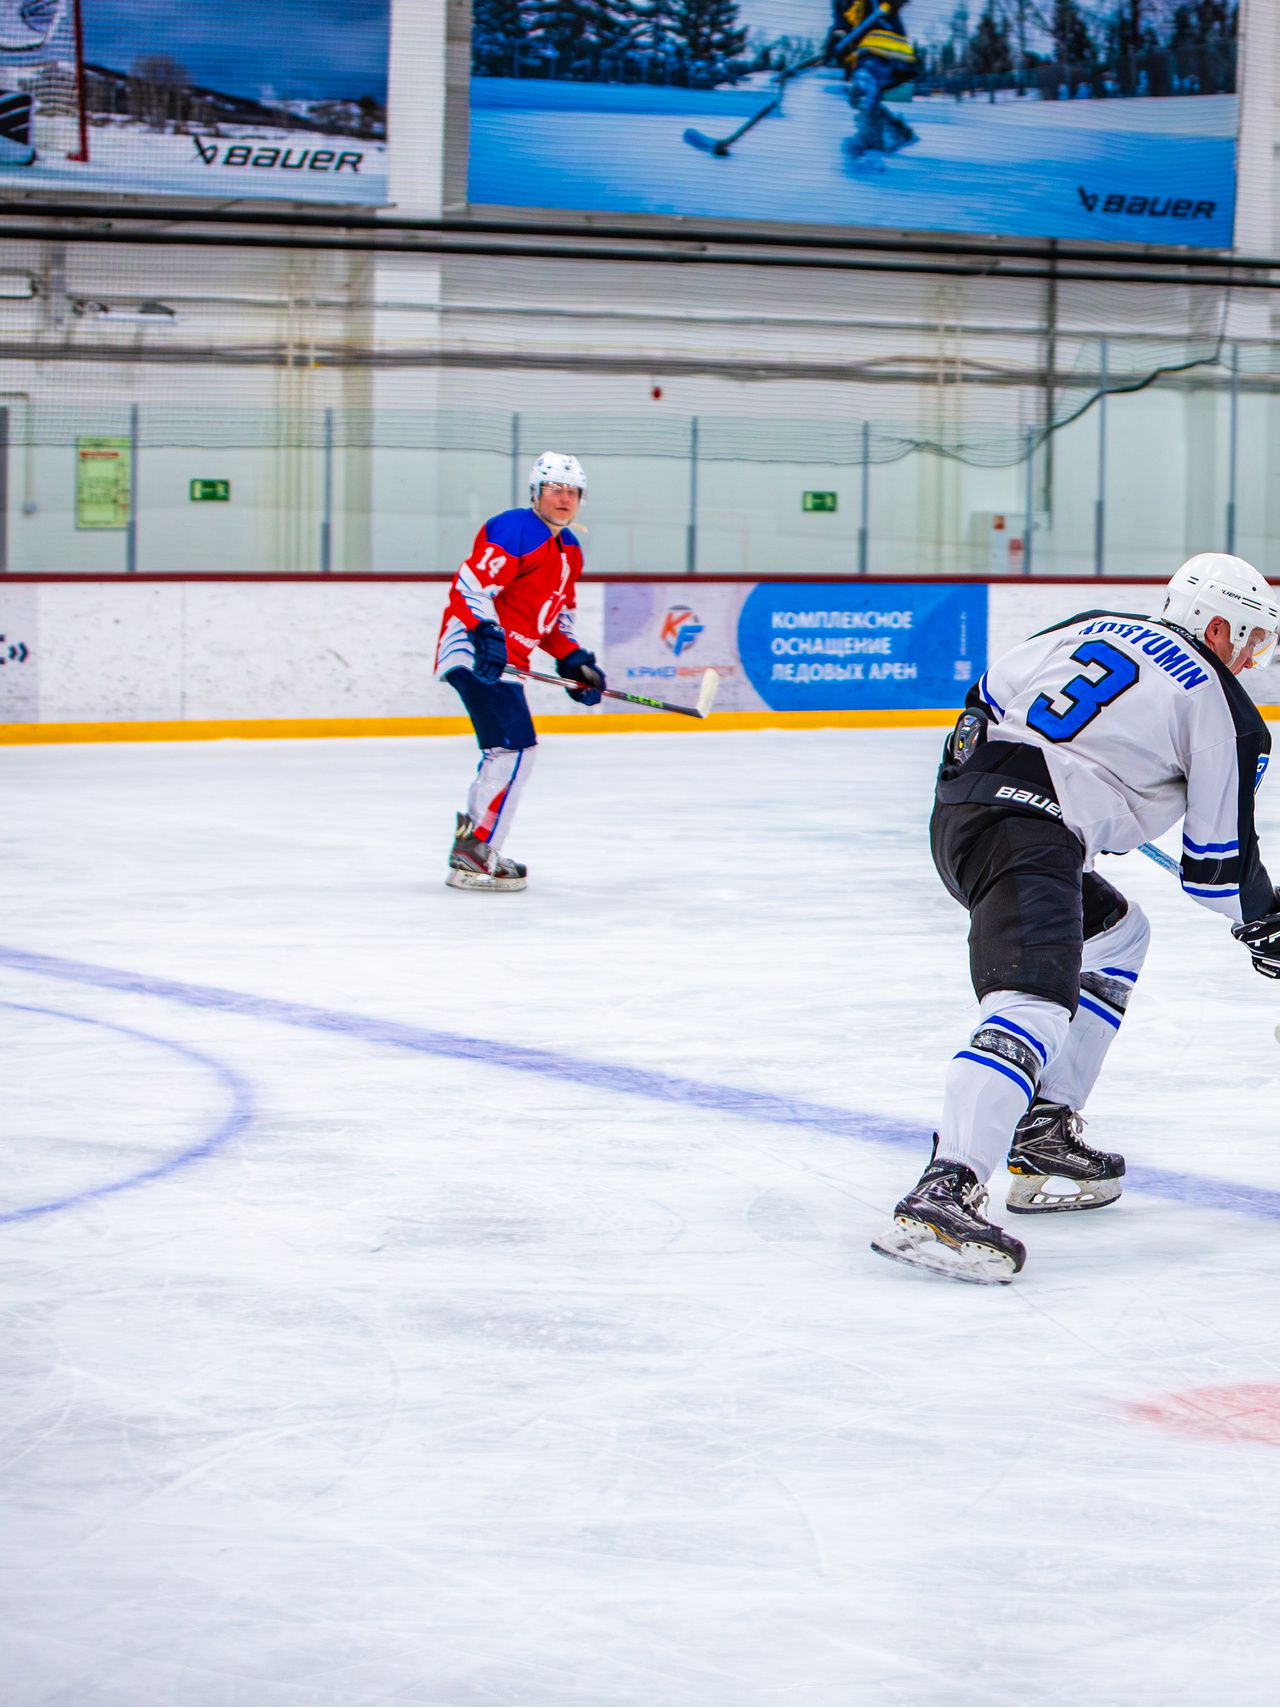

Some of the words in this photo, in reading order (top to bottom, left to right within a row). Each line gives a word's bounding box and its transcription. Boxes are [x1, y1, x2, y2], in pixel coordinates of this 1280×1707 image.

[222, 145, 363, 172] BAUER
[1103, 194, 1216, 219] BAUER
[476, 546, 507, 579] 14
[771, 611, 913, 629] КОМПЛЕКСНОЕ
[661, 612, 705, 656] KF
[771, 637, 892, 657] ОСНАЩЕНИЕ
[771, 662, 864, 683] ЛЕДОВЫХ
[869, 662, 917, 680] АРЕН
[1026, 638, 1140, 743] 3
[995, 786, 1063, 820] BAUE
